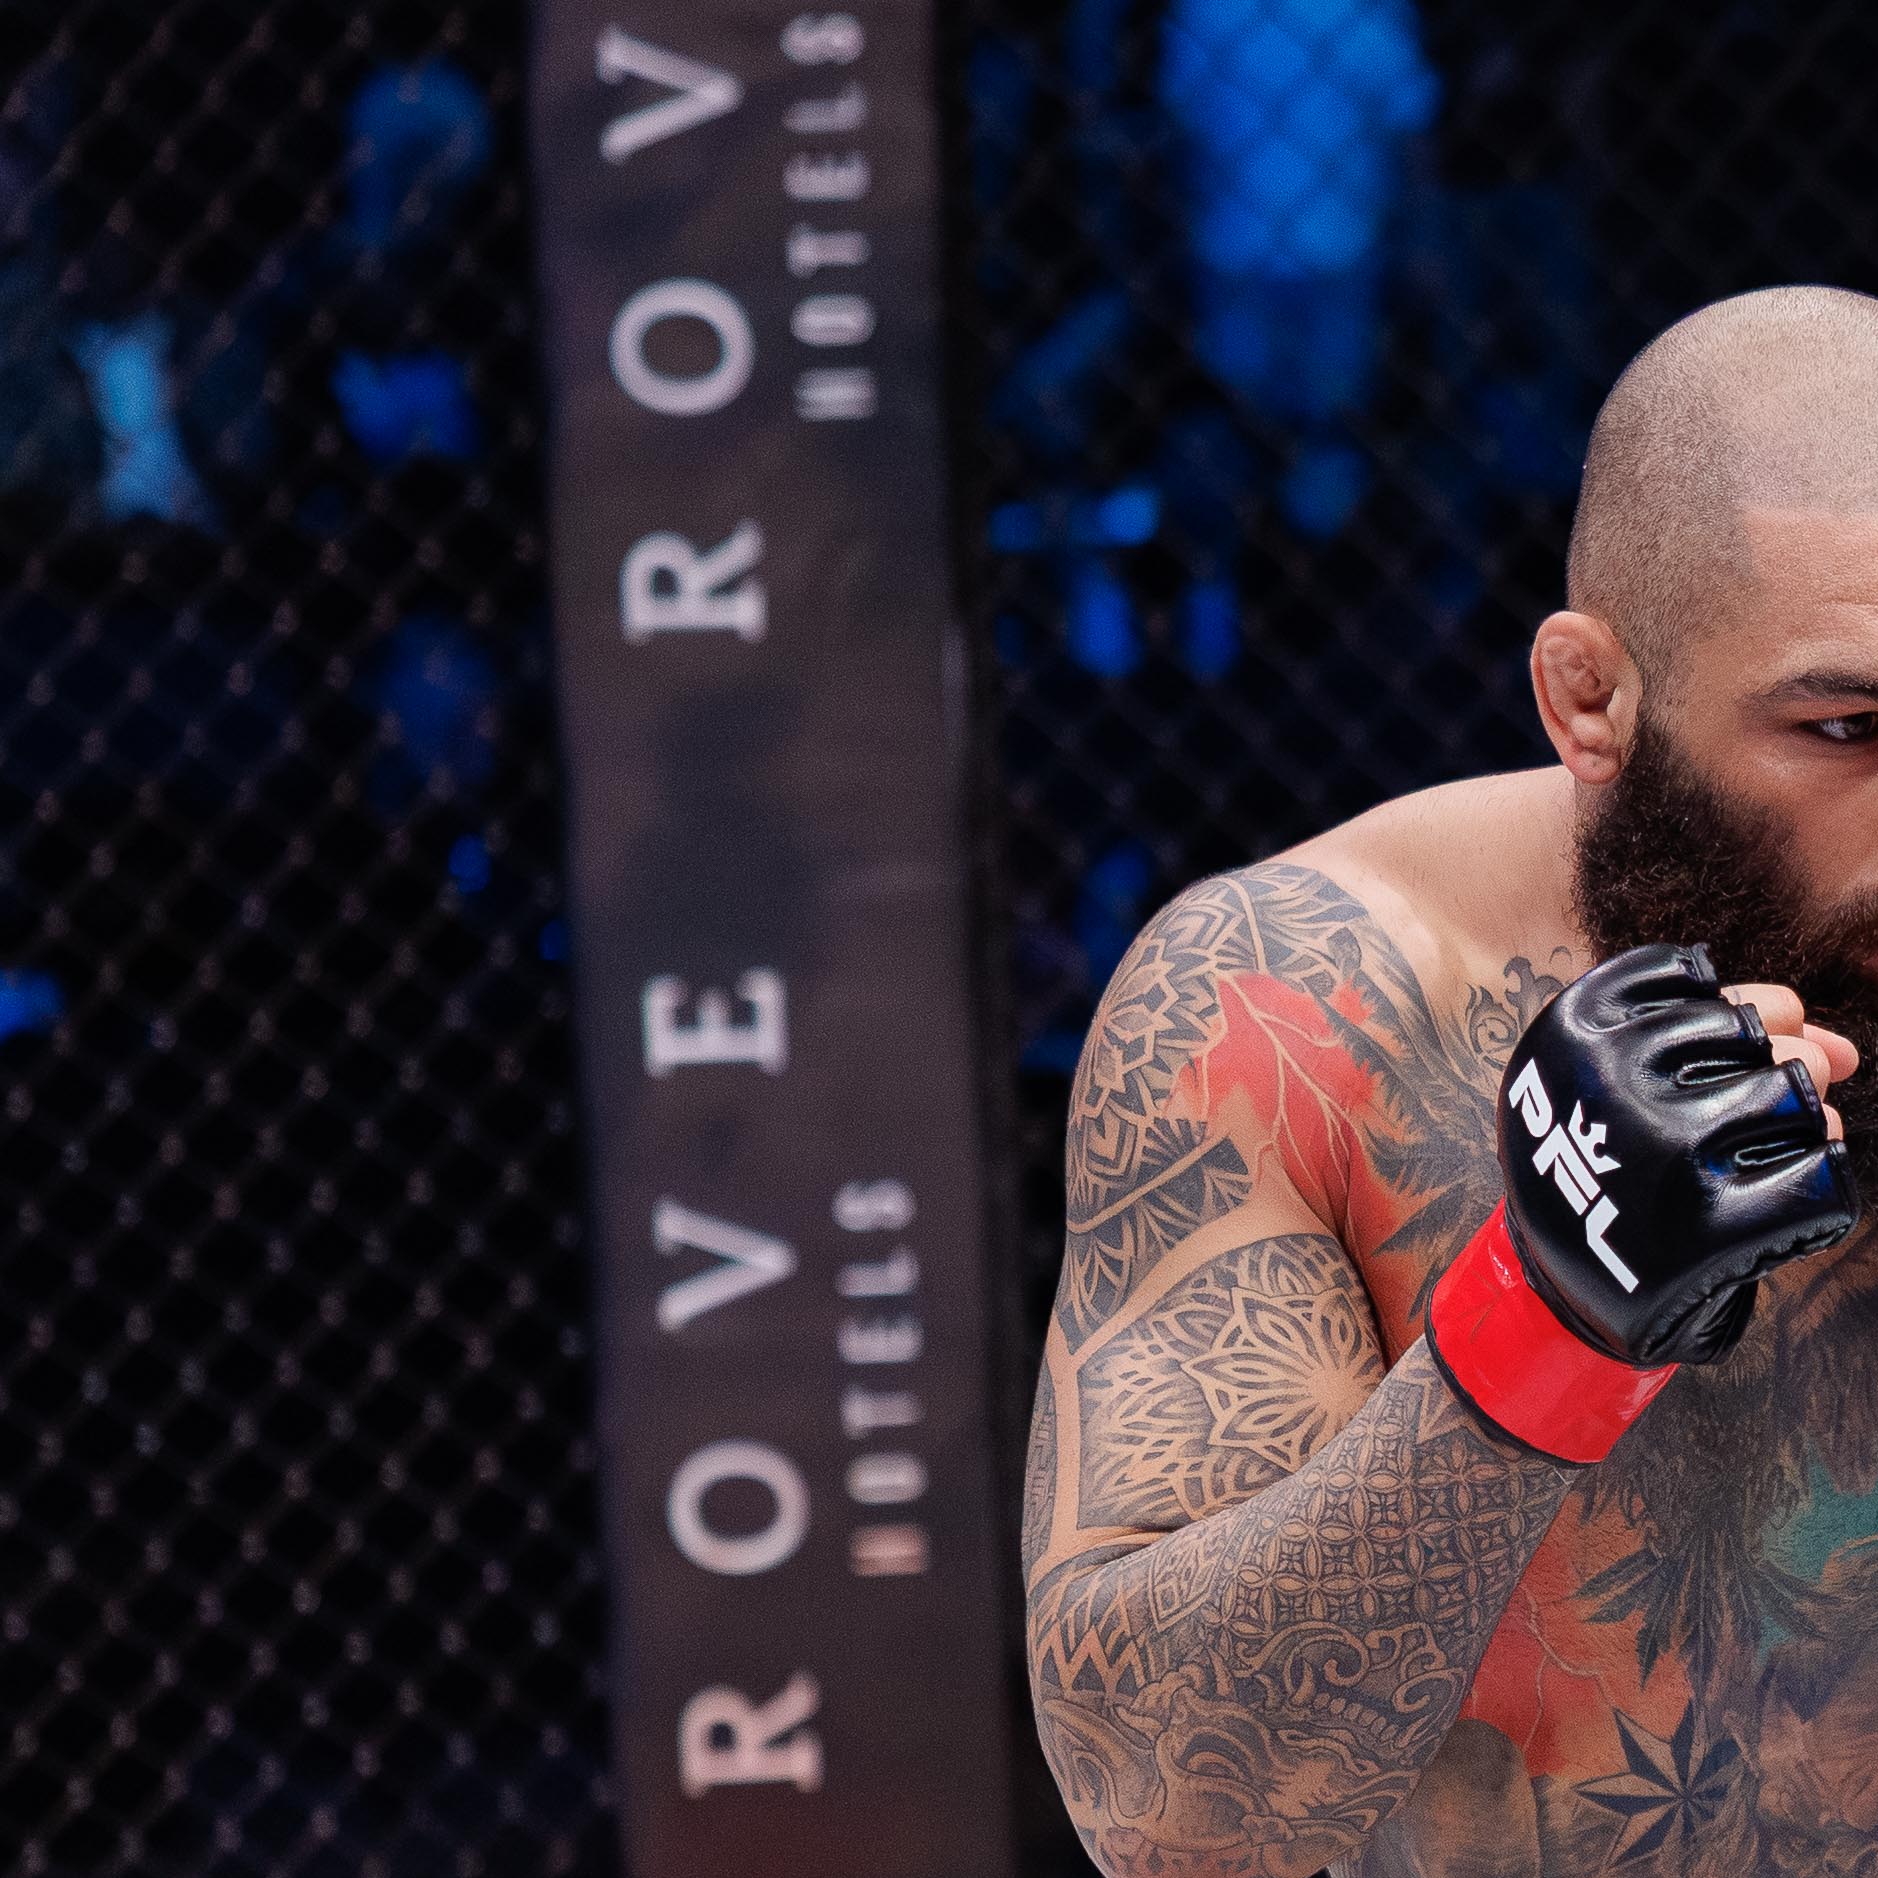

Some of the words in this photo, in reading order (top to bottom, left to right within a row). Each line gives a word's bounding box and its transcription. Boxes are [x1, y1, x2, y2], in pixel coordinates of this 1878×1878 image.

[1508, 1056, 1640, 1294] PFL
[640, 964, 825, 1799] ROVE
[832, 1177, 929, 1578] HOTELS
